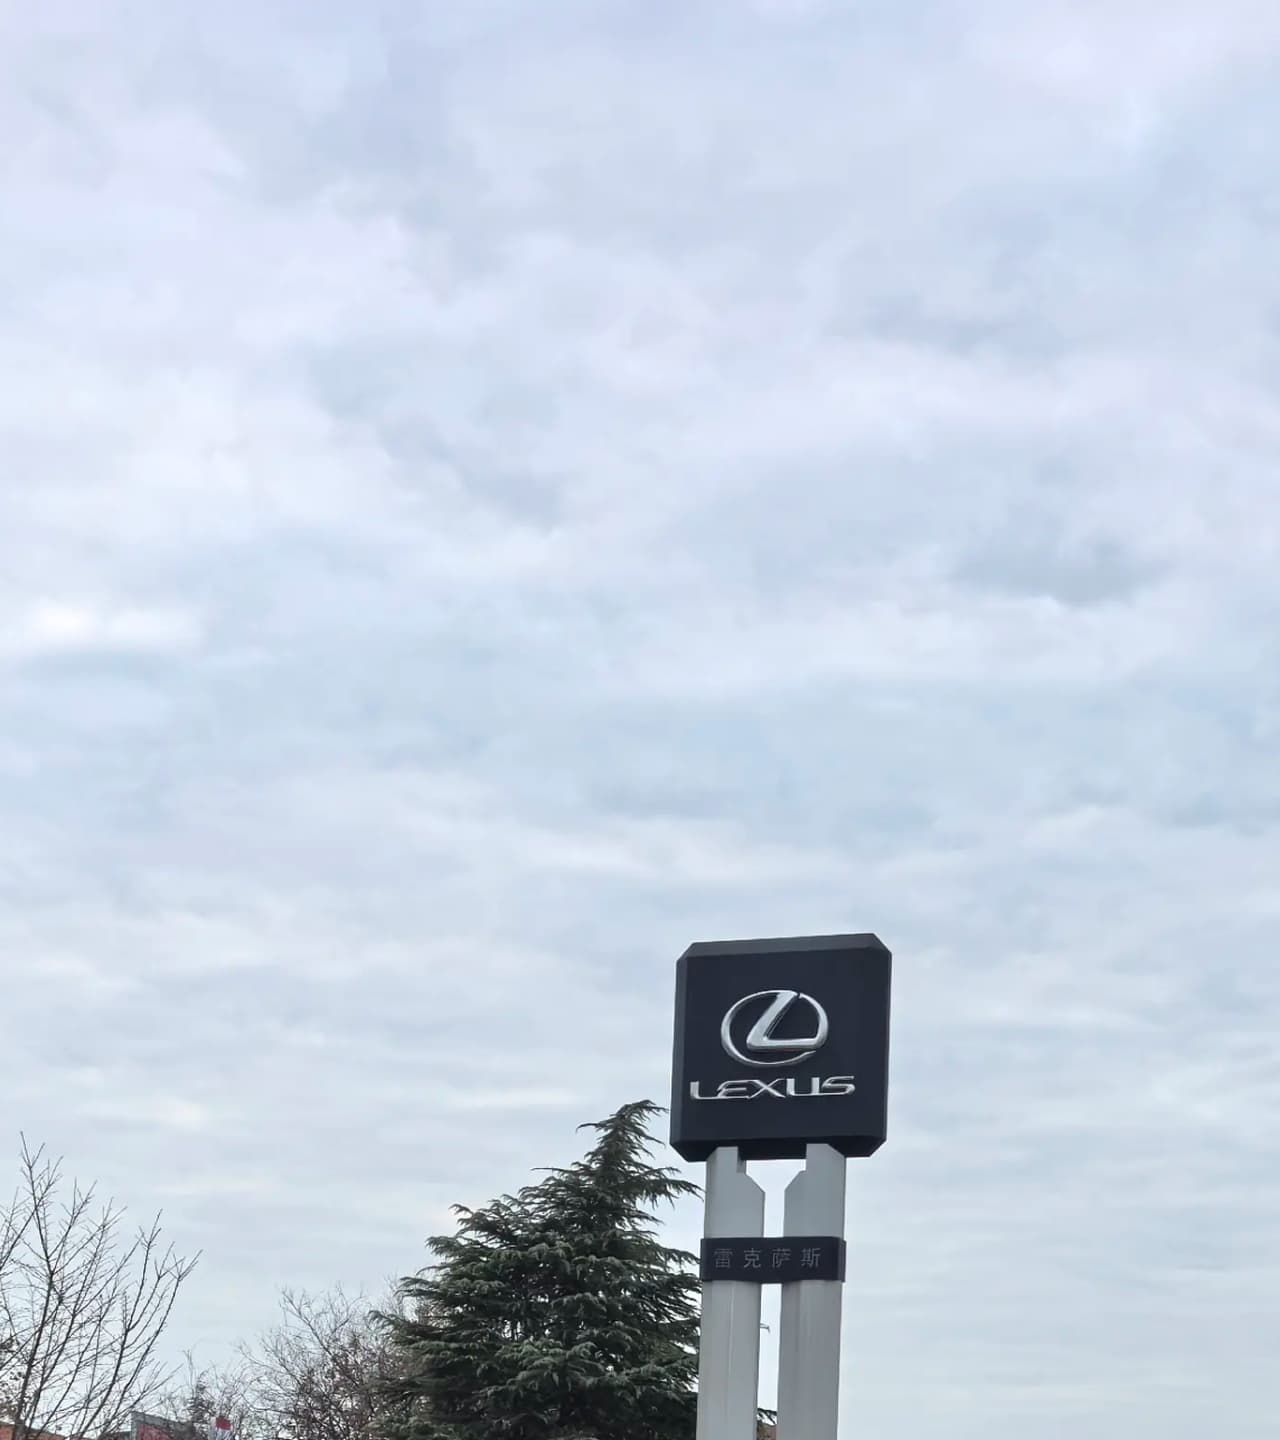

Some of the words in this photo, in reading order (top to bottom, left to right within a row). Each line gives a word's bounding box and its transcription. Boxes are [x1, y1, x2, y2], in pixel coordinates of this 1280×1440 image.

[690, 1076, 855, 1099] LEXUS
[714, 1247, 821, 1269] 雷克萨斯
